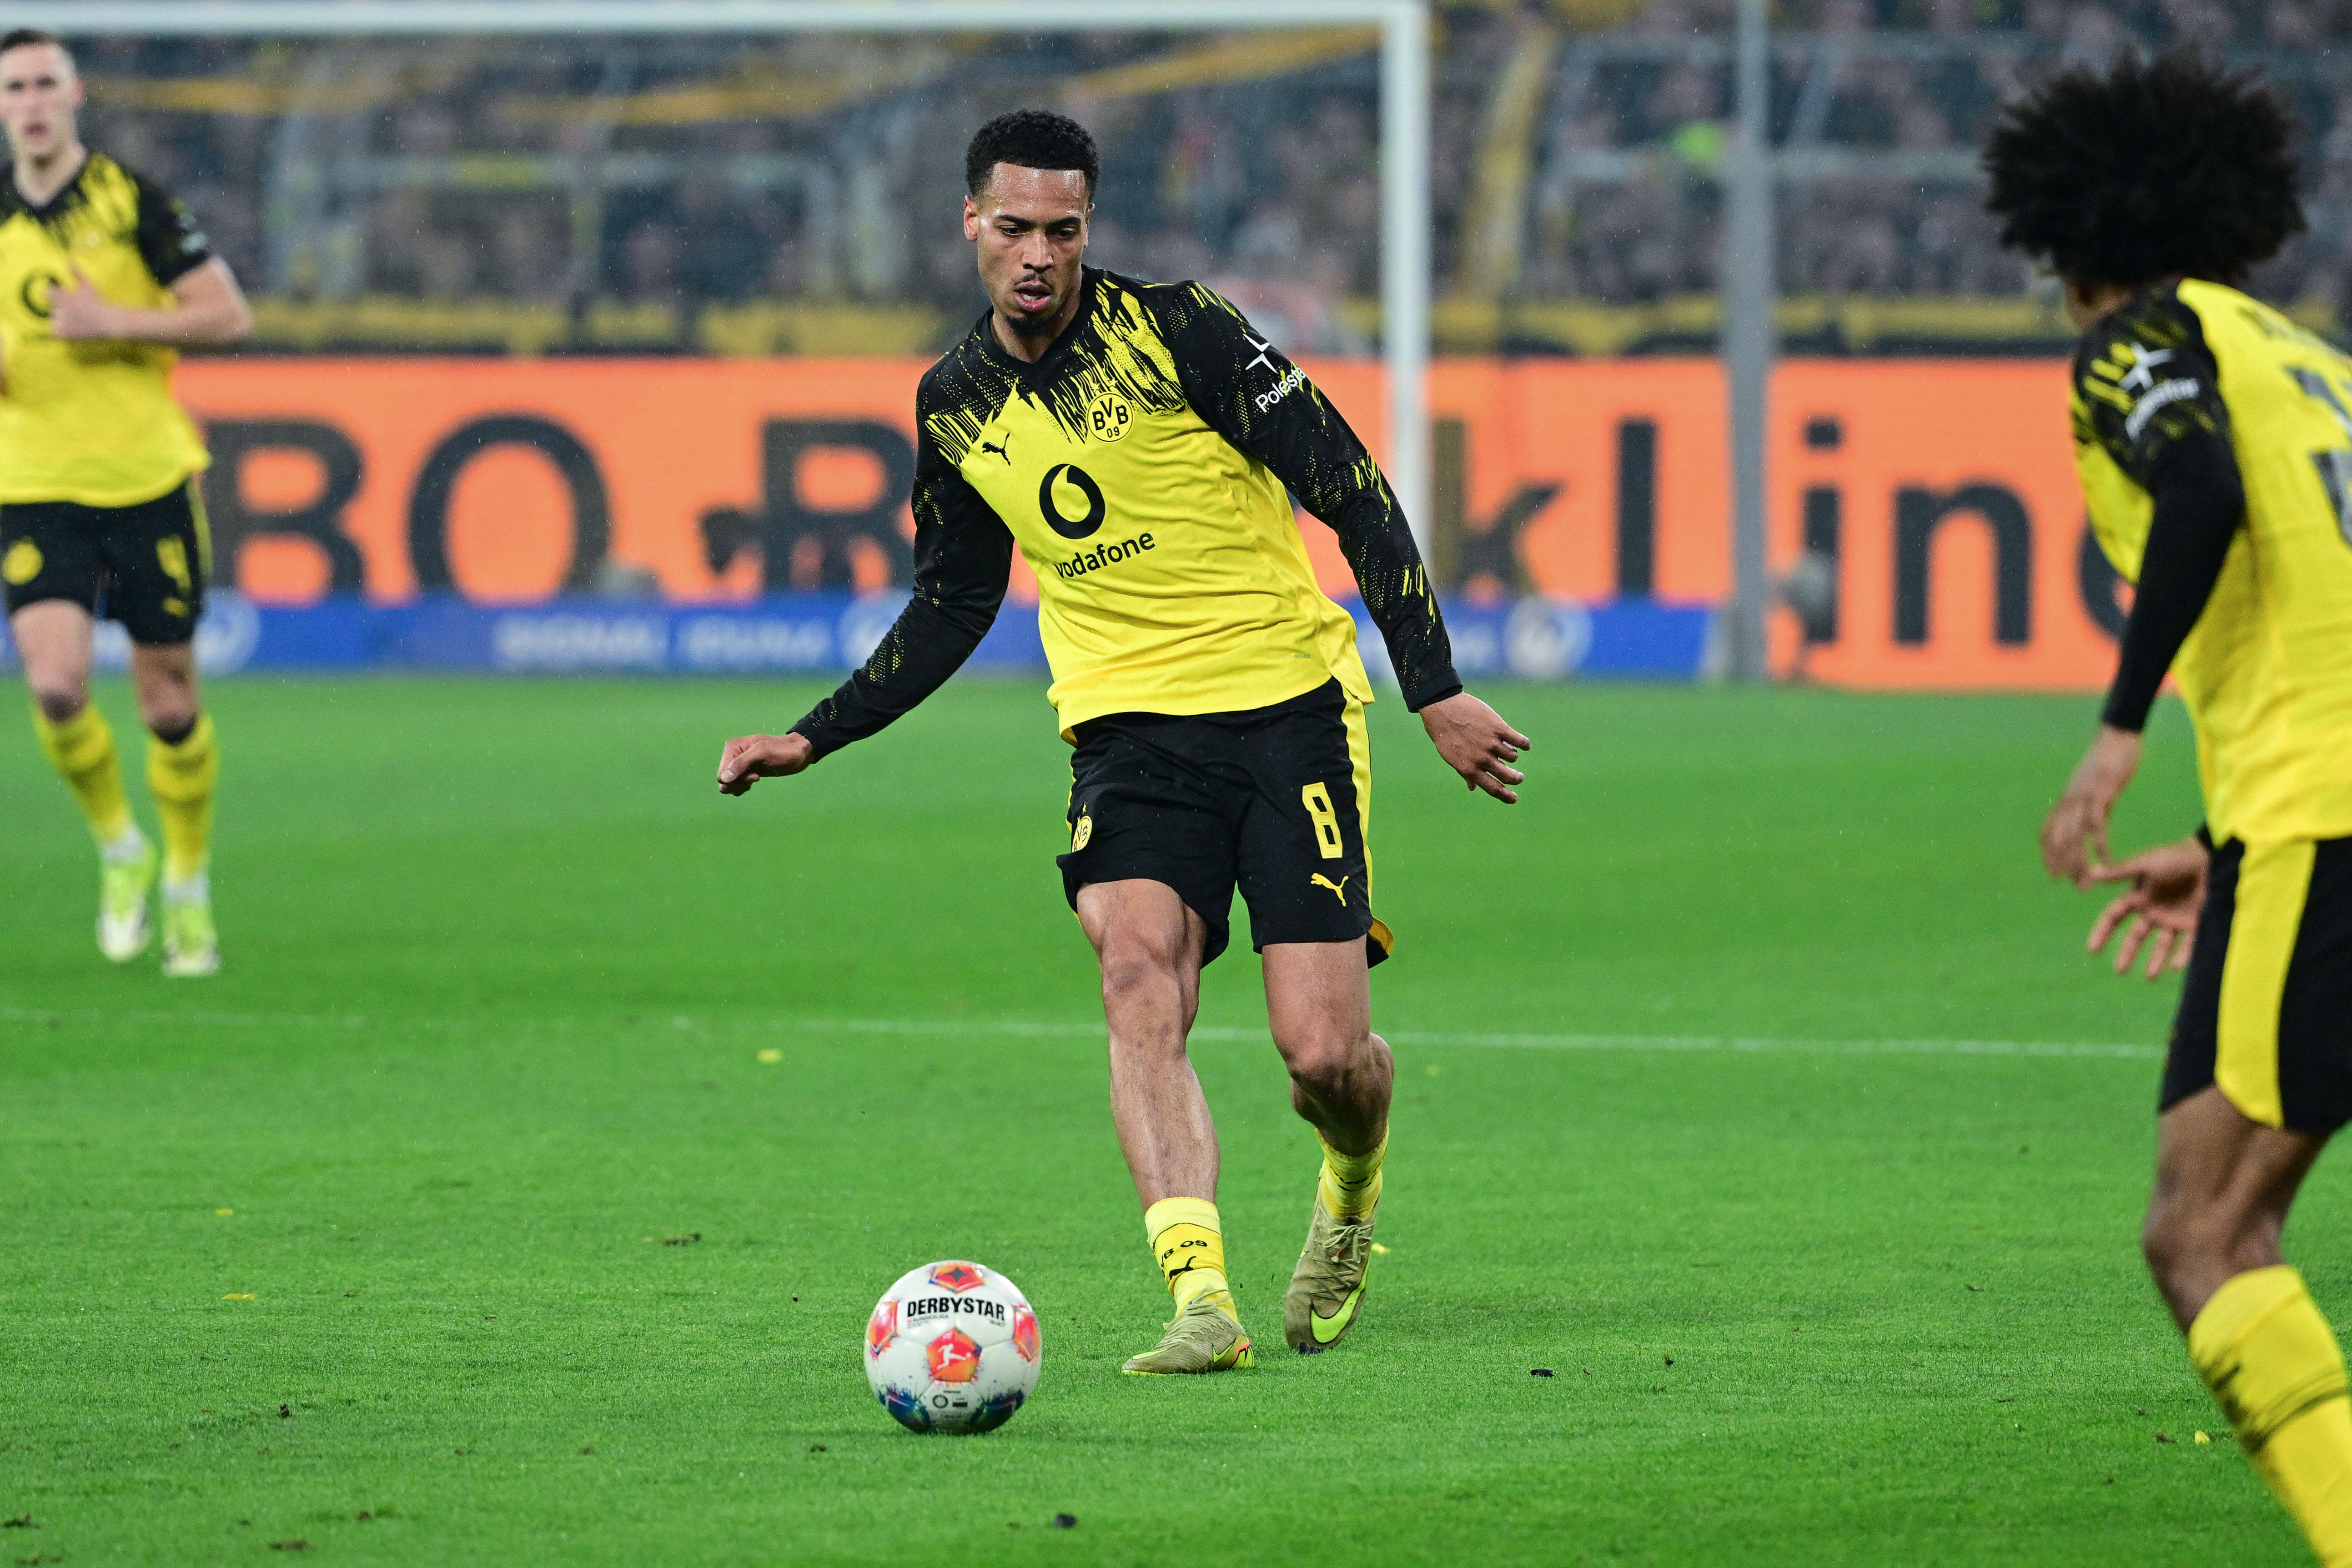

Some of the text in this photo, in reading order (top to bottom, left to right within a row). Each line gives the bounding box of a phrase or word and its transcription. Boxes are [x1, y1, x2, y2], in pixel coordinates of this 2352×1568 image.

[1092, 397, 1129, 431] BVB
[1106, 427, 1120, 438] 09
[1053, 533, 1156, 579] vodafone
[1302, 781, 1342, 859] 8
[907, 1297, 1005, 1321] DERBYSTAR
